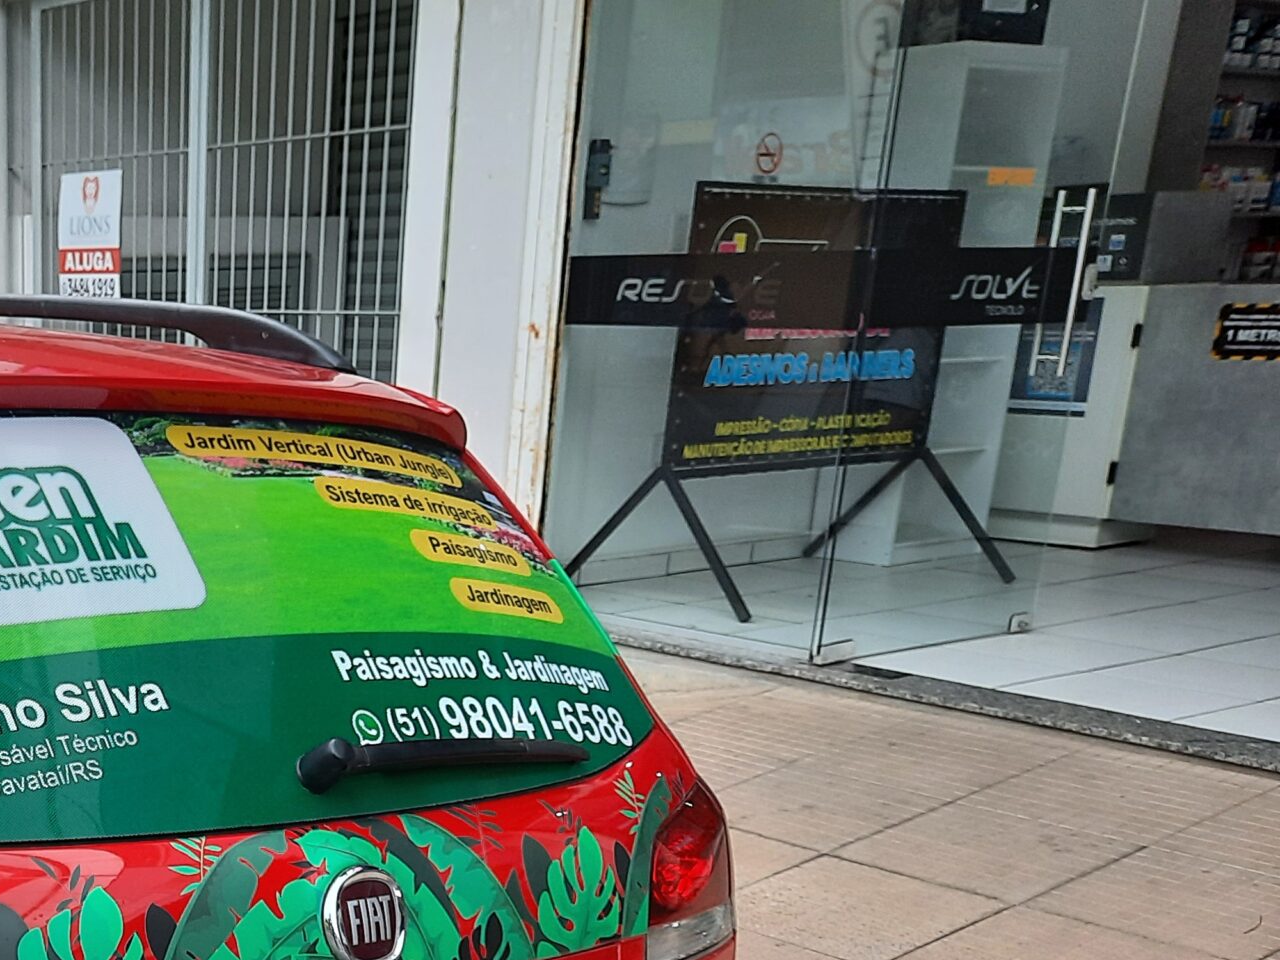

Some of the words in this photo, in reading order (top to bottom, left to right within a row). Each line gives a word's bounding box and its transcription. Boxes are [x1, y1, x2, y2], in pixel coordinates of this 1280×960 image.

[70, 214, 112, 236] LIONS
[64, 250, 114, 272] ALUGA
[184, 431, 254, 453] Jardim
[263, 436, 333, 459] Vertical
[337, 439, 396, 469] (Urban
[399, 453, 452, 483] Jungle)
[325, 485, 399, 510] Sistema
[403, 493, 423, 512] de
[426, 497, 492, 526] irrigação
[429, 536, 518, 568] Paisagismo
[66, 567, 89, 584] DE
[90, 563, 157, 584] SERVIÇO
[467, 584, 553, 614] Jardinagem
[331, 649, 477, 687] Paisagismo
[478, 650, 501, 679] &
[504, 652, 610, 694] Jardinagem
[54, 679, 170, 722] Silva
[386, 706, 441, 742] (51)
[439, 697, 634, 747] 98041-6588
[57, 729, 138, 756] Técnico
[346, 894, 392, 946] FIAT
